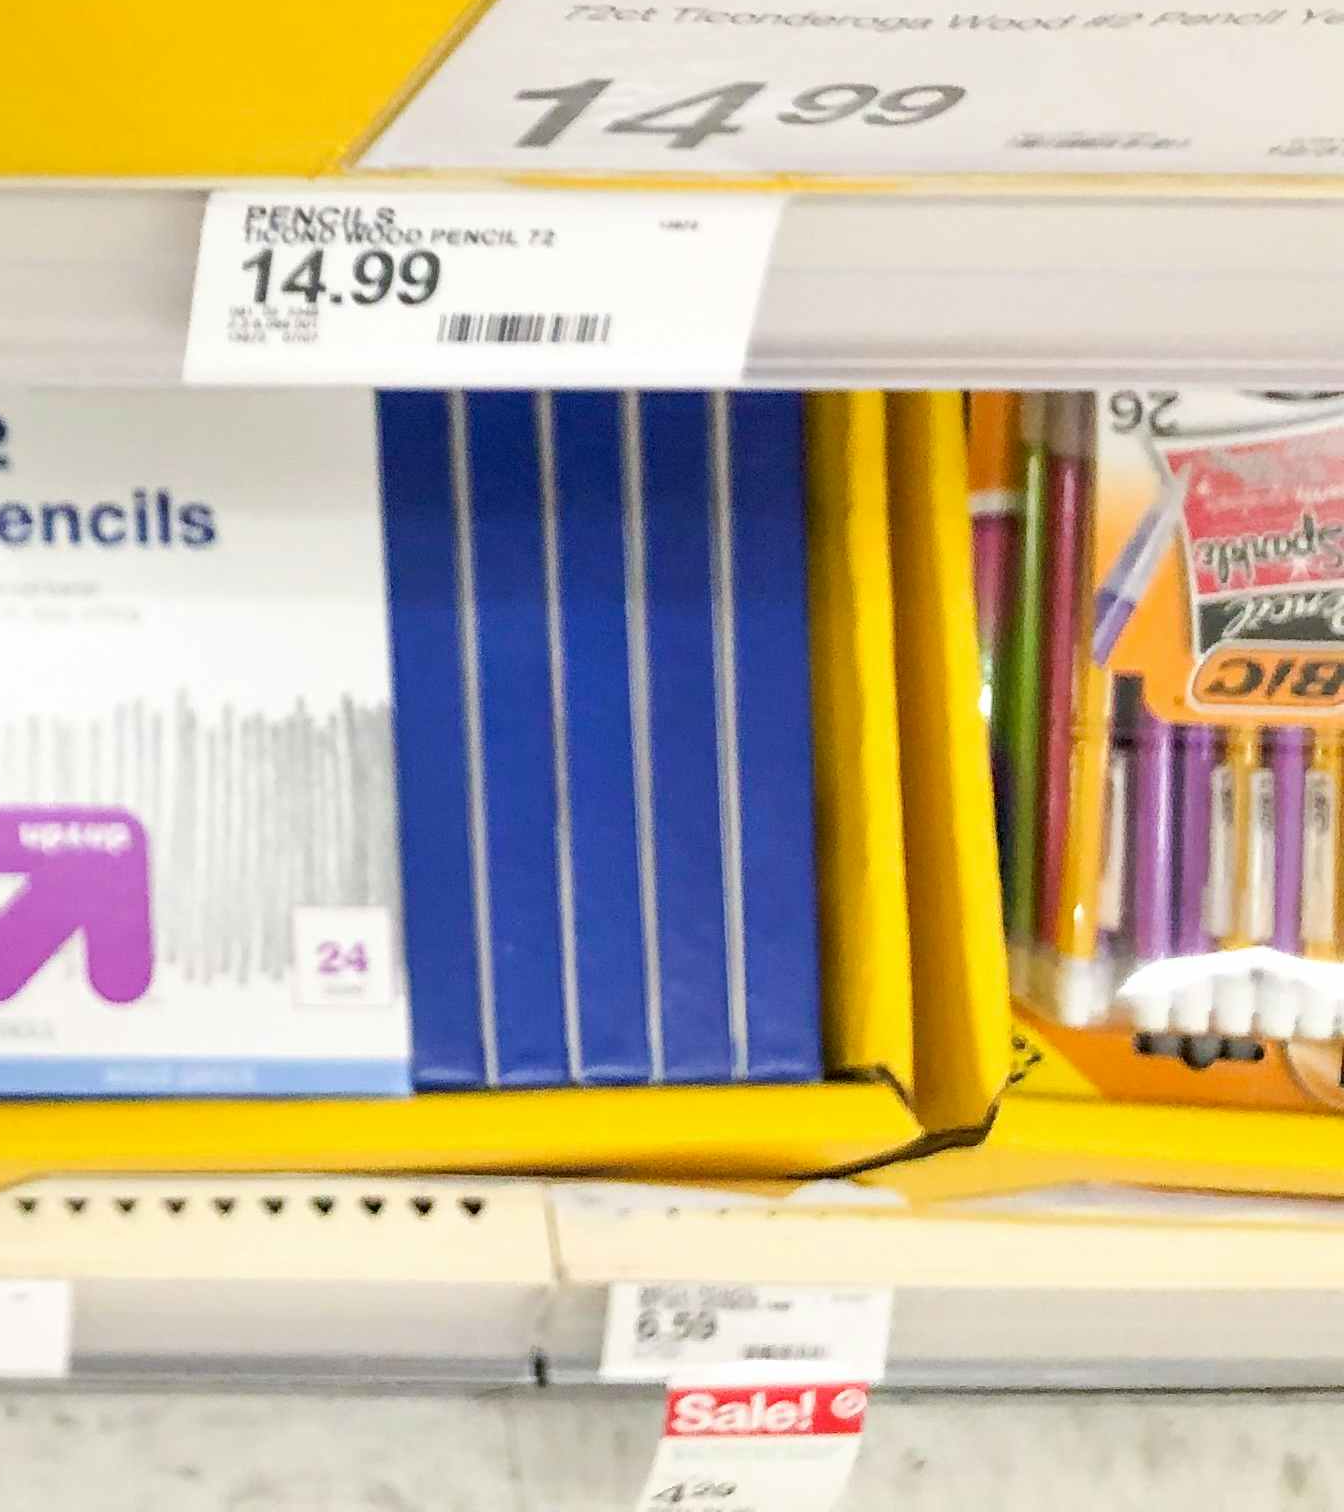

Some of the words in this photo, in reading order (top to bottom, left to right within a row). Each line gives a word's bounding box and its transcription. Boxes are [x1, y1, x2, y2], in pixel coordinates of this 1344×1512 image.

[563, 4, 656, 22] 72ct
[672, 6, 935, 34] Ticonderoga
[947, 10, 1077, 31] Wood
[1148, 8, 1288, 28] Pencil
[243, 205, 396, 227] PENCILS
[345, 224, 423, 246] WOOD
[430, 229, 518, 246] PENCIL
[527, 229, 556, 246] 72
[241, 248, 442, 305] 14.99
[1205, 655, 1344, 697] BIC
[315, 941, 369, 974] 24
[673, 1392, 816, 1433] Sale!
